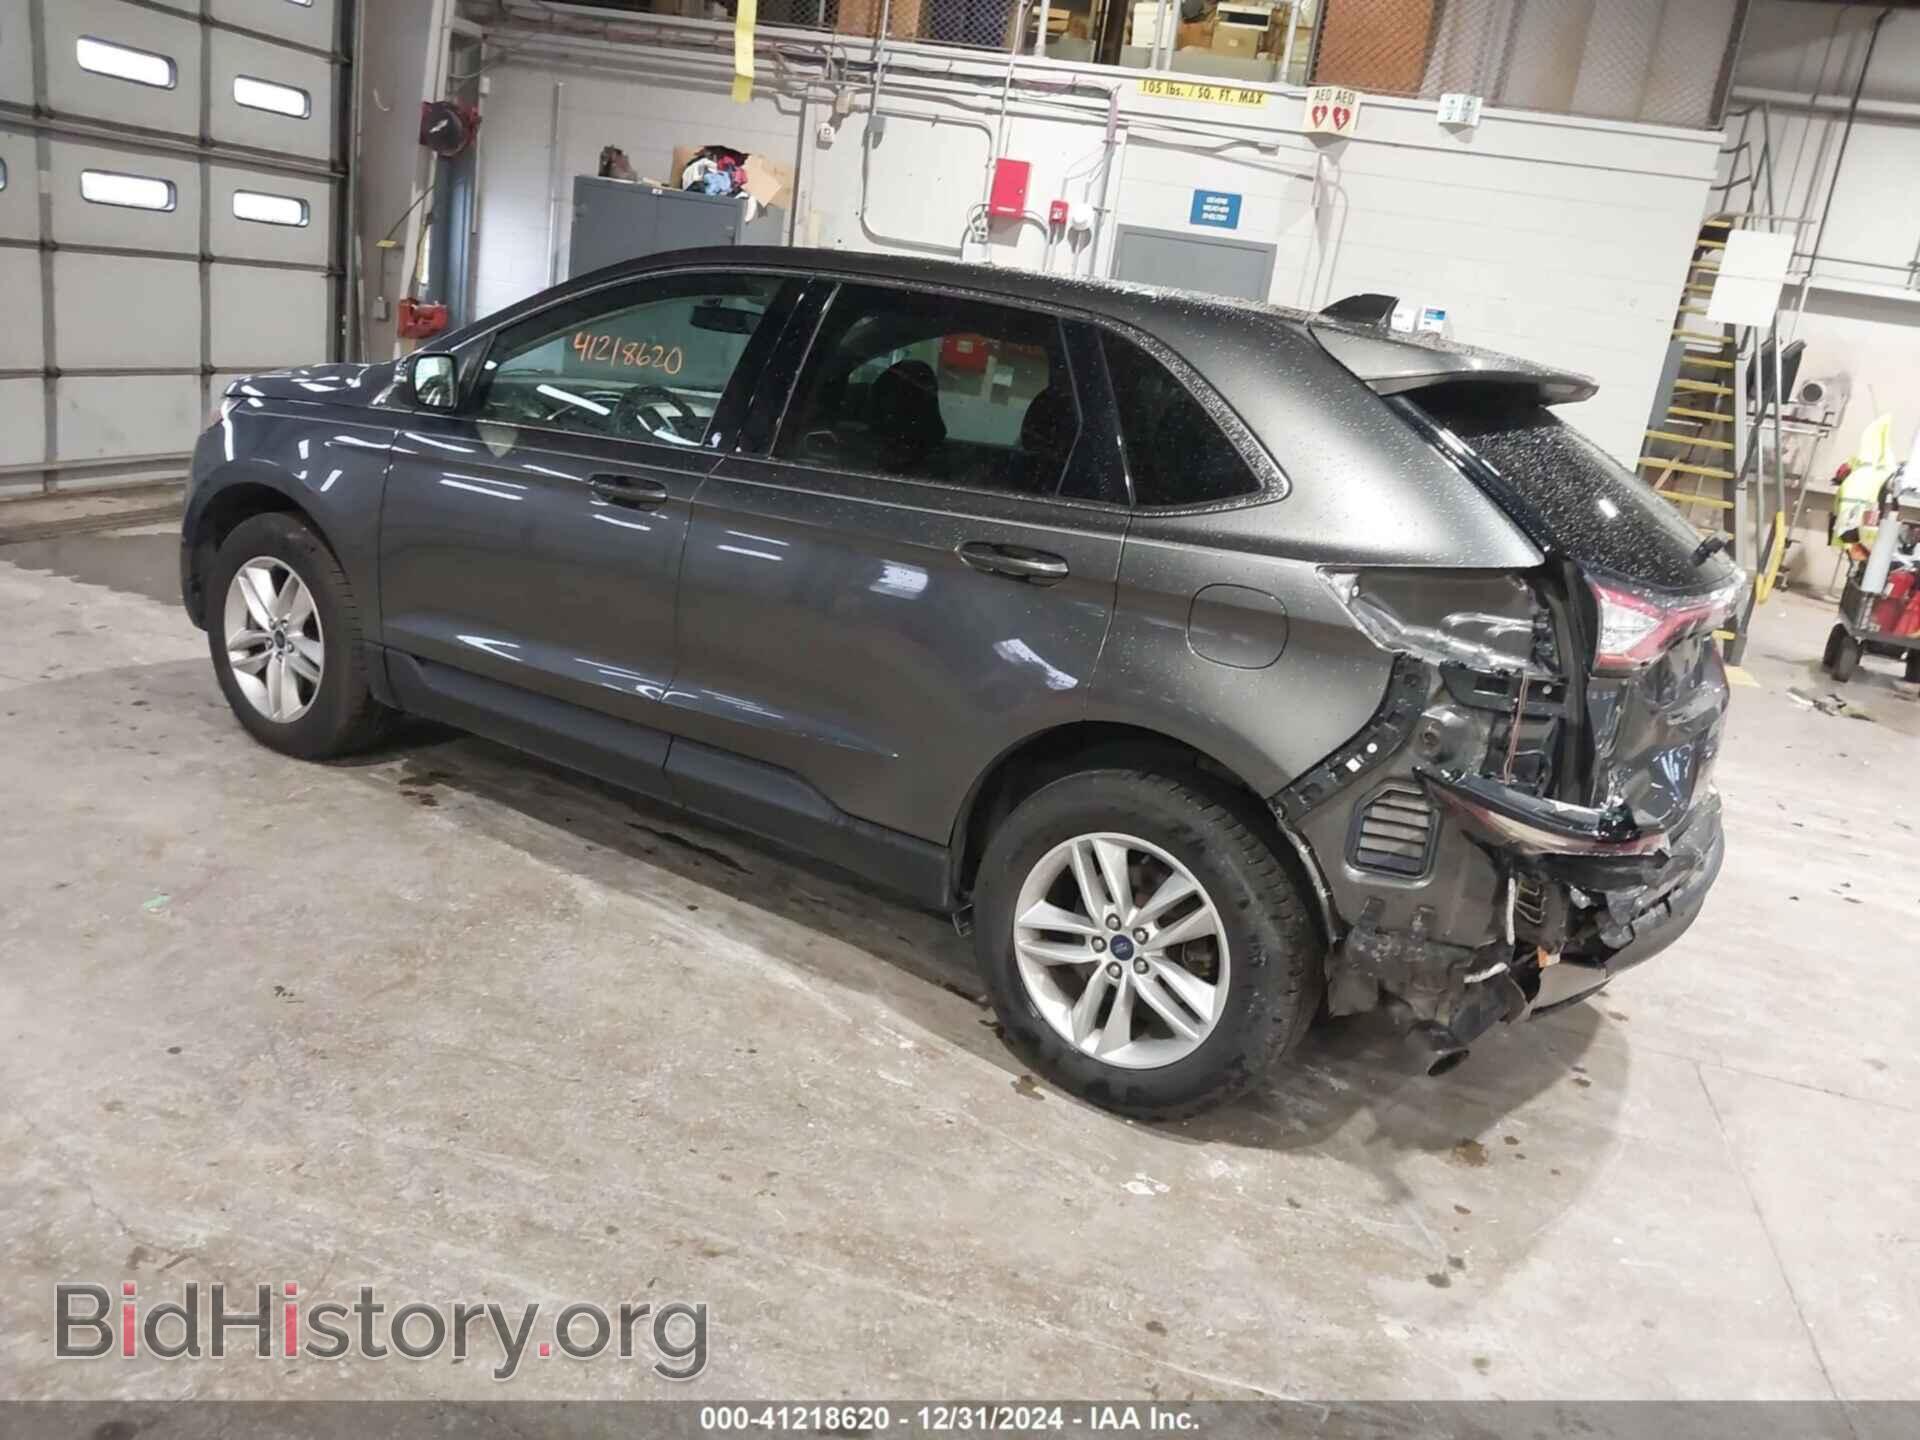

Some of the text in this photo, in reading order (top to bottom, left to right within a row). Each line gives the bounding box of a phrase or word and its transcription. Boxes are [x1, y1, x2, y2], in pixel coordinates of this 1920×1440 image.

[1142, 80, 1161, 93] 105
[1166, 83, 1184, 96] lbs.
[1198, 87, 1214, 100] SQ.
[1219, 89, 1234, 102] FT.
[1239, 91, 1264, 104] MAX
[1315, 89, 1331, 101] AED
[1336, 91, 1356, 105] AED
[573, 331, 682, 375] 41218620
